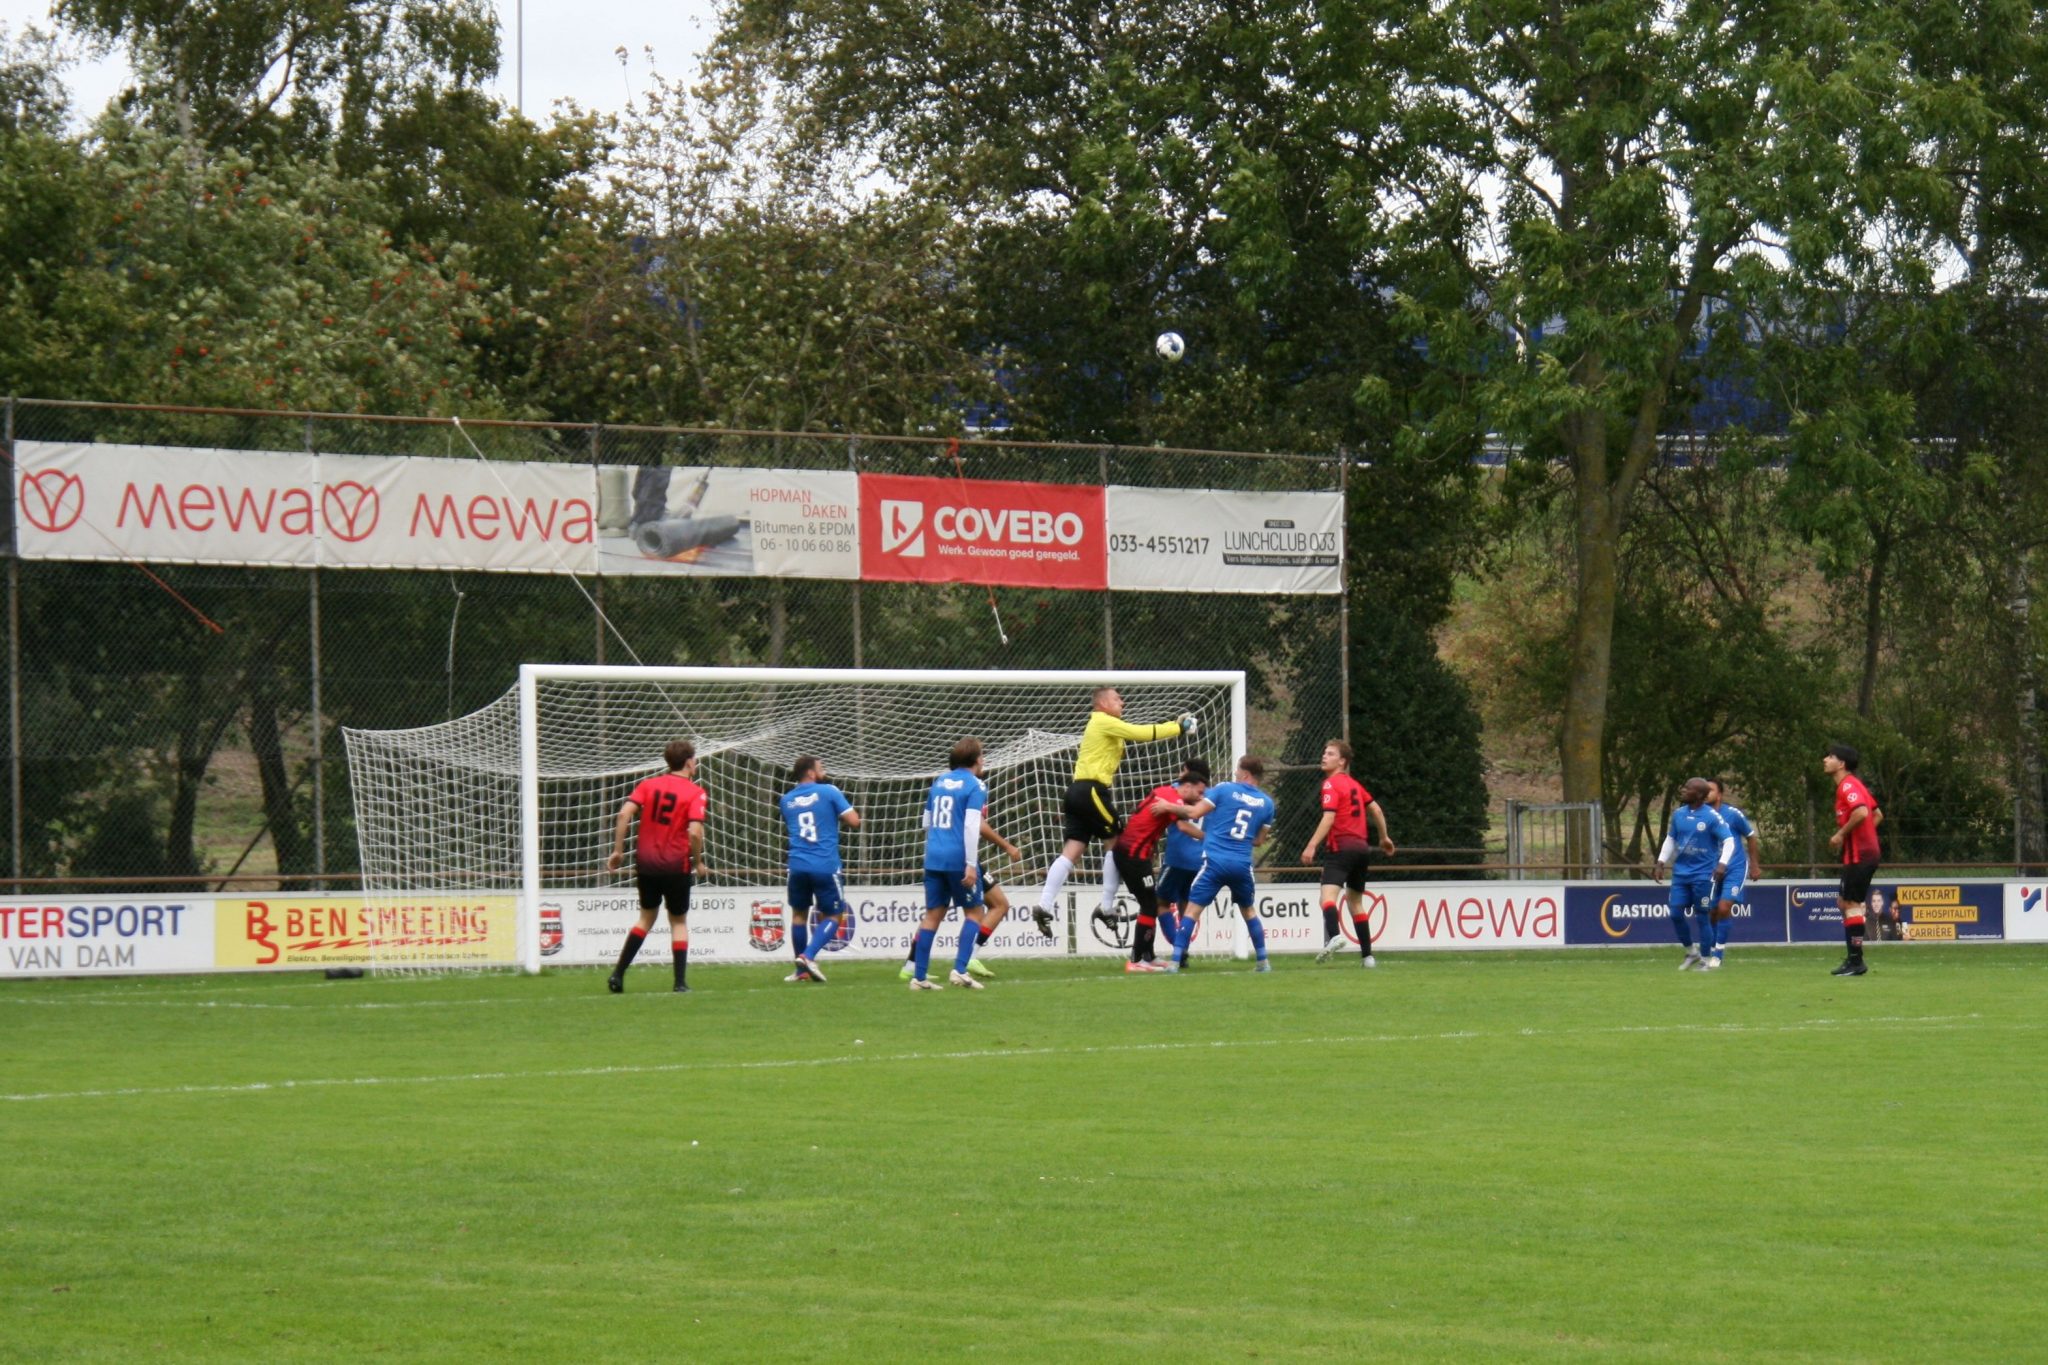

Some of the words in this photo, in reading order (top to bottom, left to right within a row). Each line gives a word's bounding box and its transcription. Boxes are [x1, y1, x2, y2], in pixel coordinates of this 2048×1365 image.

[750, 488, 811, 503] HOPMAN
[802, 504, 847, 518] DAKEN
[754, 520, 804, 534] Bitumen
[808, 522, 816, 535] &
[820, 522, 855, 535] EPDM
[933, 506, 1083, 545] COVEBO
[760, 538, 776, 550] 06
[786, 539, 799, 551] 10
[802, 540, 816, 552] 06
[819, 540, 834, 552] 60
[836, 541, 851, 552] 86
[1110, 534, 1209, 554] 033-4551217
[1225, 531, 1306, 551] LUNCHCLUB
[1310, 533, 1336, 551] 033
[938, 544, 966, 555] Werk.
[968, 545, 1007, 557] Gewoon
[1009, 548, 1034, 559] goed
[1036, 550, 1080, 561] geregeld.
[653, 790, 677, 825] 12
[932, 796, 954, 828] 18
[798, 811, 818, 842] 8
[1230, 810, 1252, 840] 5
[1796, 891, 1823, 899] BASTION
[1902, 888, 1956, 900] KICKSTART
[703, 899, 736, 910] BOYS
[1259, 896, 1309, 918] Gent
[1914, 910, 1925, 918] JE
[1926, 909, 1976, 918] HOSPITALITY
[0, 904, 185, 939] TERSPORT
[287, 908, 347, 937] BEN
[1910, 926, 1952, 937] CARRIÈRE
[861, 935, 896, 947] voor
[993, 935, 1011, 947] en
[9, 946, 62, 968] VAN
[77, 945, 135, 967] DAM
